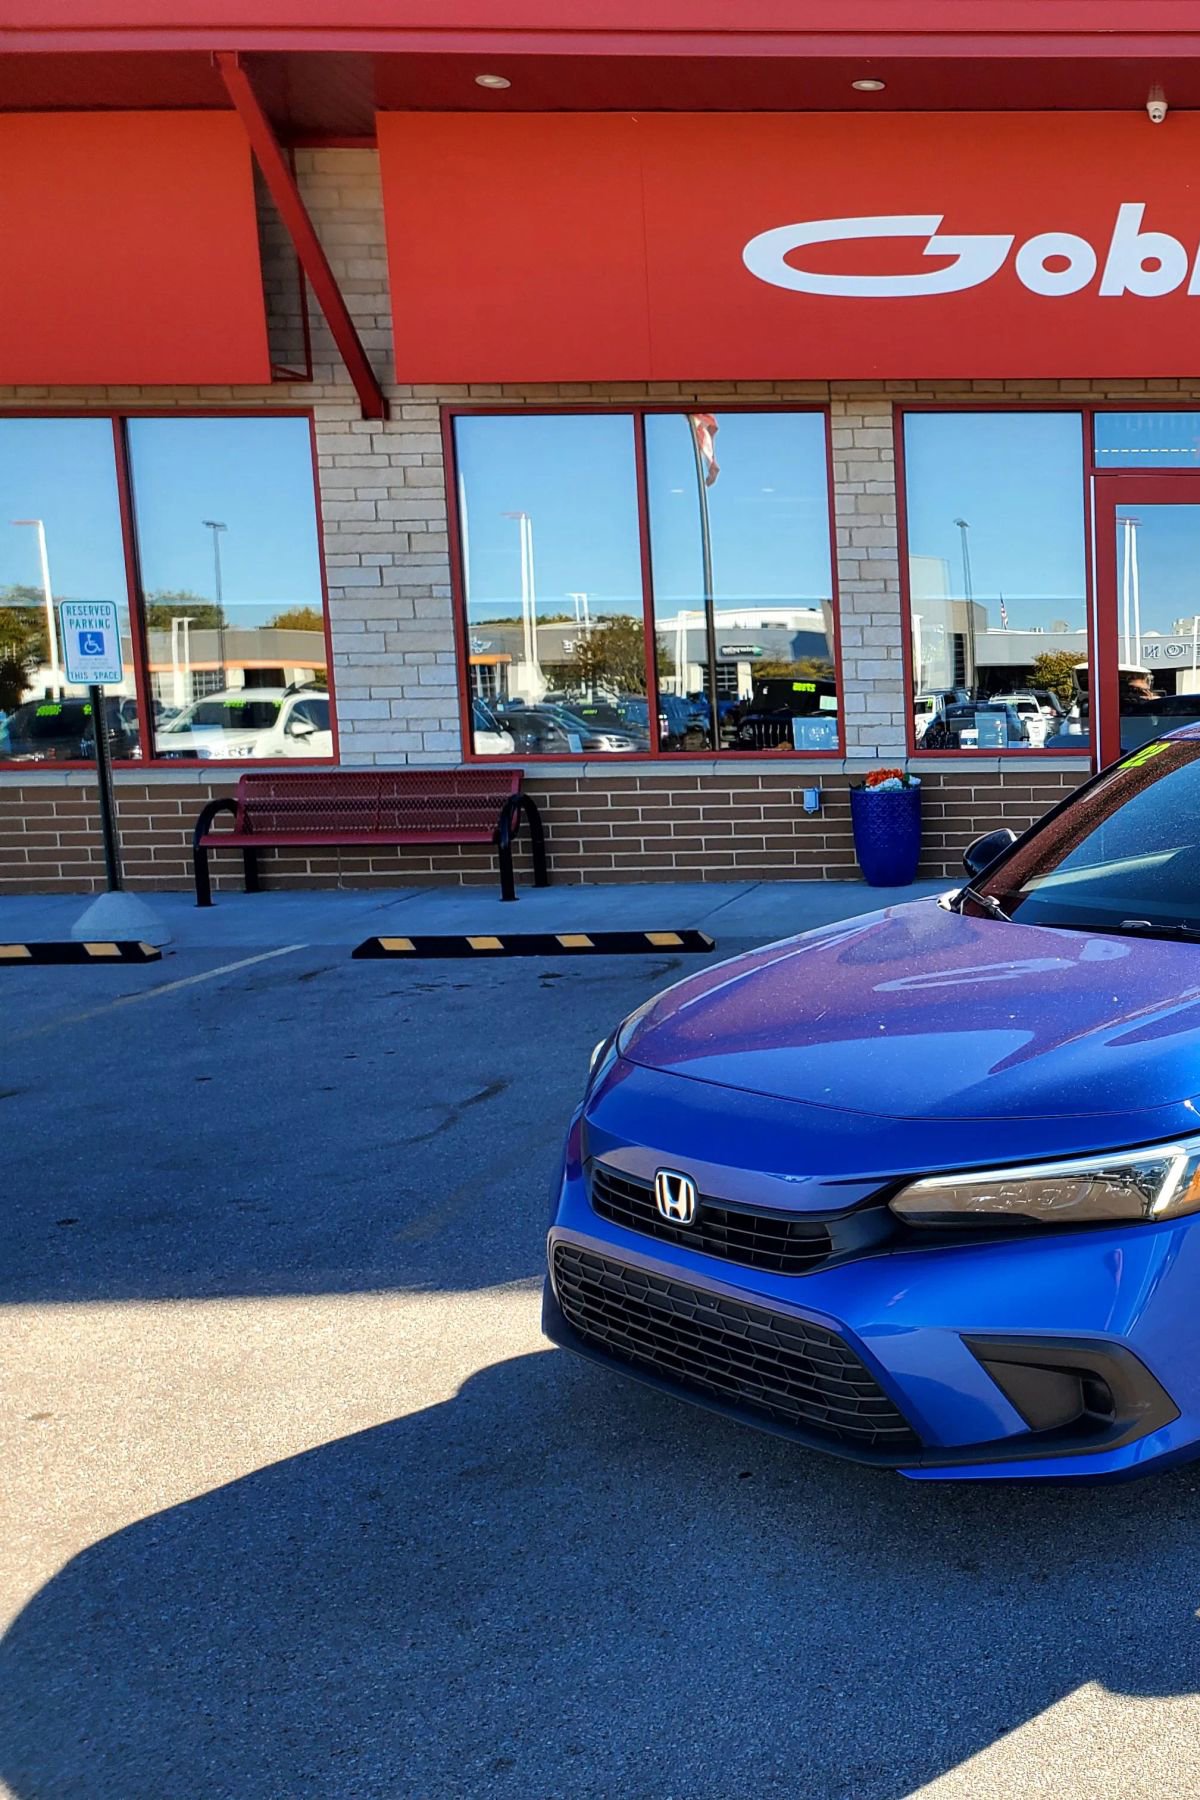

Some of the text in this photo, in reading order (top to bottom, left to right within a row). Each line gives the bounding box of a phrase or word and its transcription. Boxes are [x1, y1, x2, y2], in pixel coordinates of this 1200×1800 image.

[66, 605, 111, 616] RESERVED
[69, 618, 111, 629] PARKING
[70, 671, 118, 680] THIS SPACE
